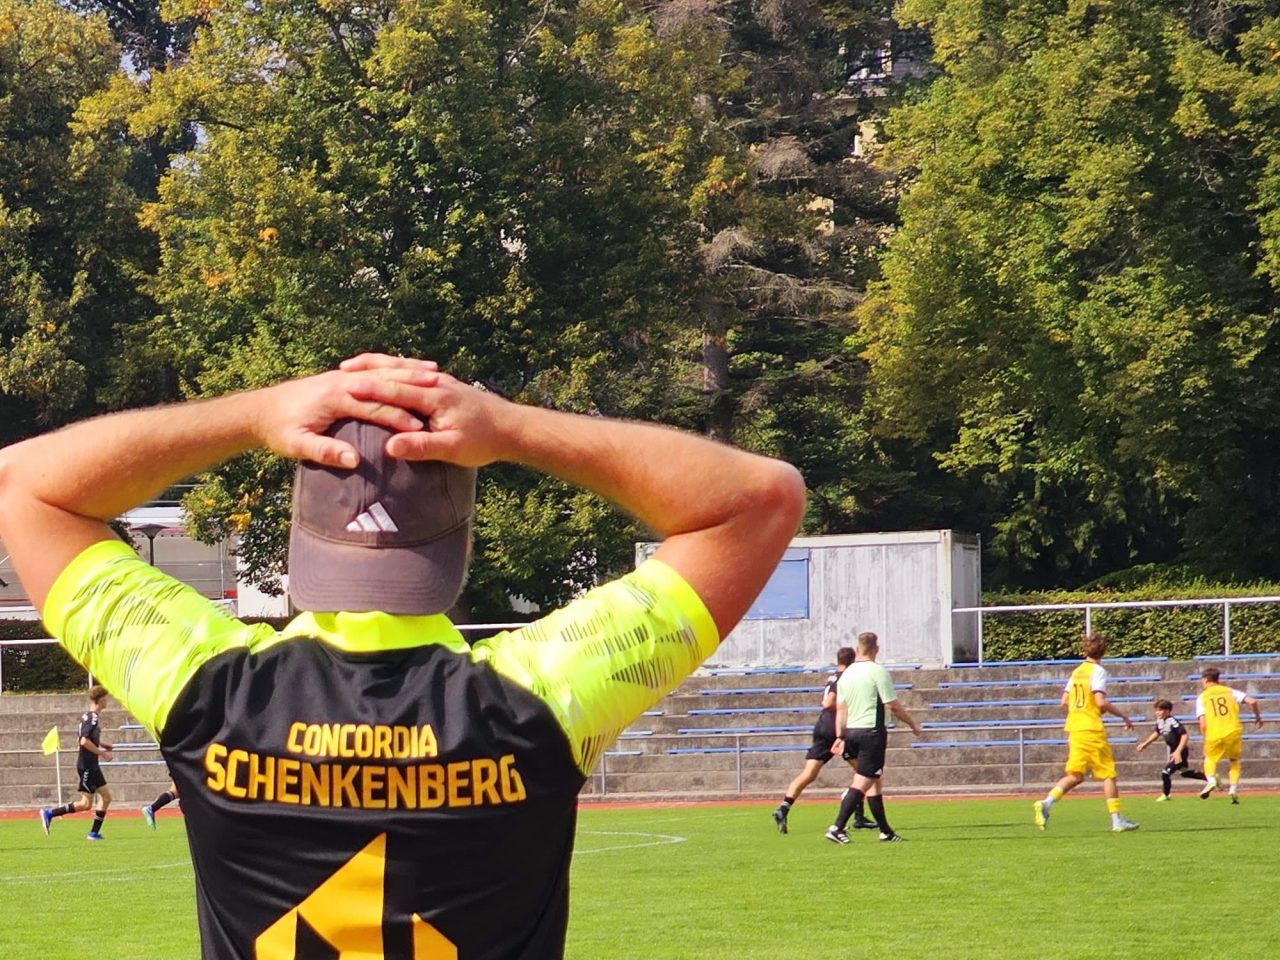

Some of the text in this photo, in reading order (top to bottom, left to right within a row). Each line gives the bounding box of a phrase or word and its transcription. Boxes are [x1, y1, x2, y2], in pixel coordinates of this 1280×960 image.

[1210, 697, 1228, 717] 18
[287, 722, 438, 758] CONCORDIA
[205, 744, 526, 809] SCHENKENBERG
